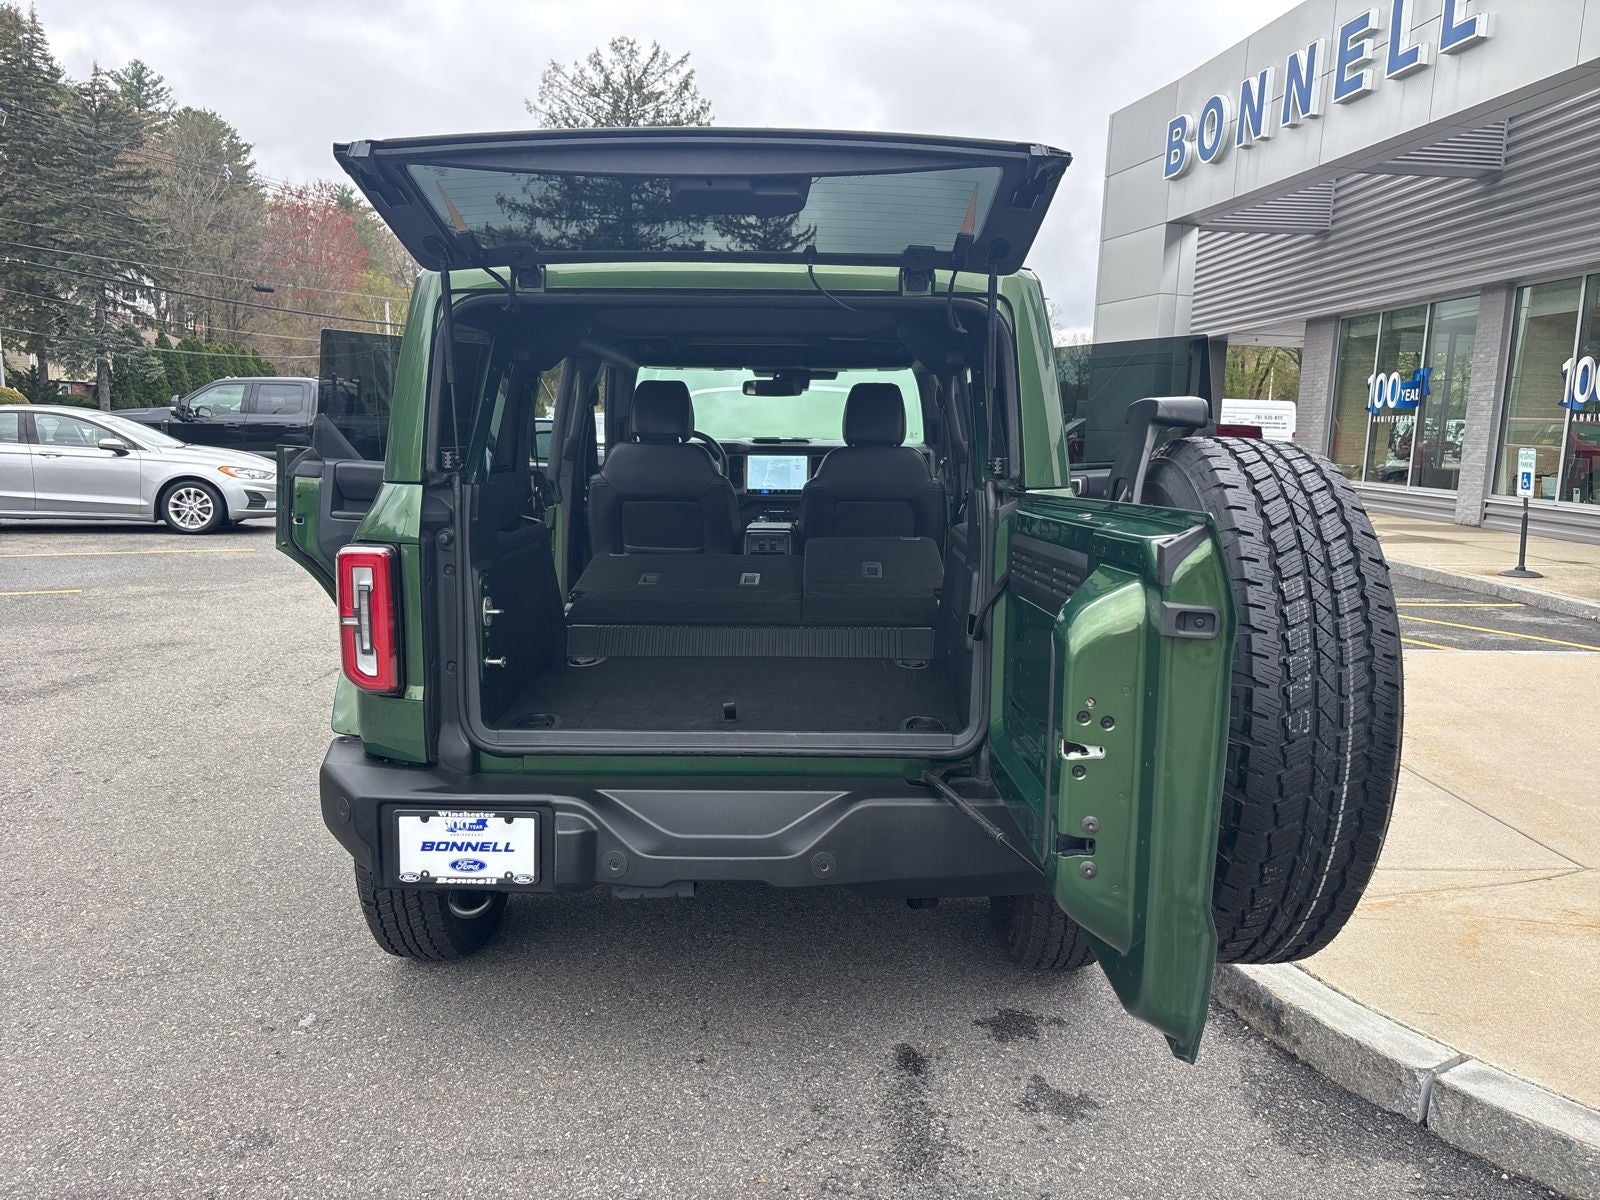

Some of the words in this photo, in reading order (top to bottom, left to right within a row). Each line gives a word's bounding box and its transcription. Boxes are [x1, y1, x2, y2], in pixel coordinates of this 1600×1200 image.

[1163, 0, 1489, 181] BONNELL
[1562, 356, 1600, 403] 10
[1367, 371, 1401, 409] 100
[437, 810, 496, 818] Winchester
[445, 818, 469, 833] 100
[420, 841, 515, 852] BONNELL
[455, 859, 481, 872] Ford
[435, 877, 498, 885] Bonnell
